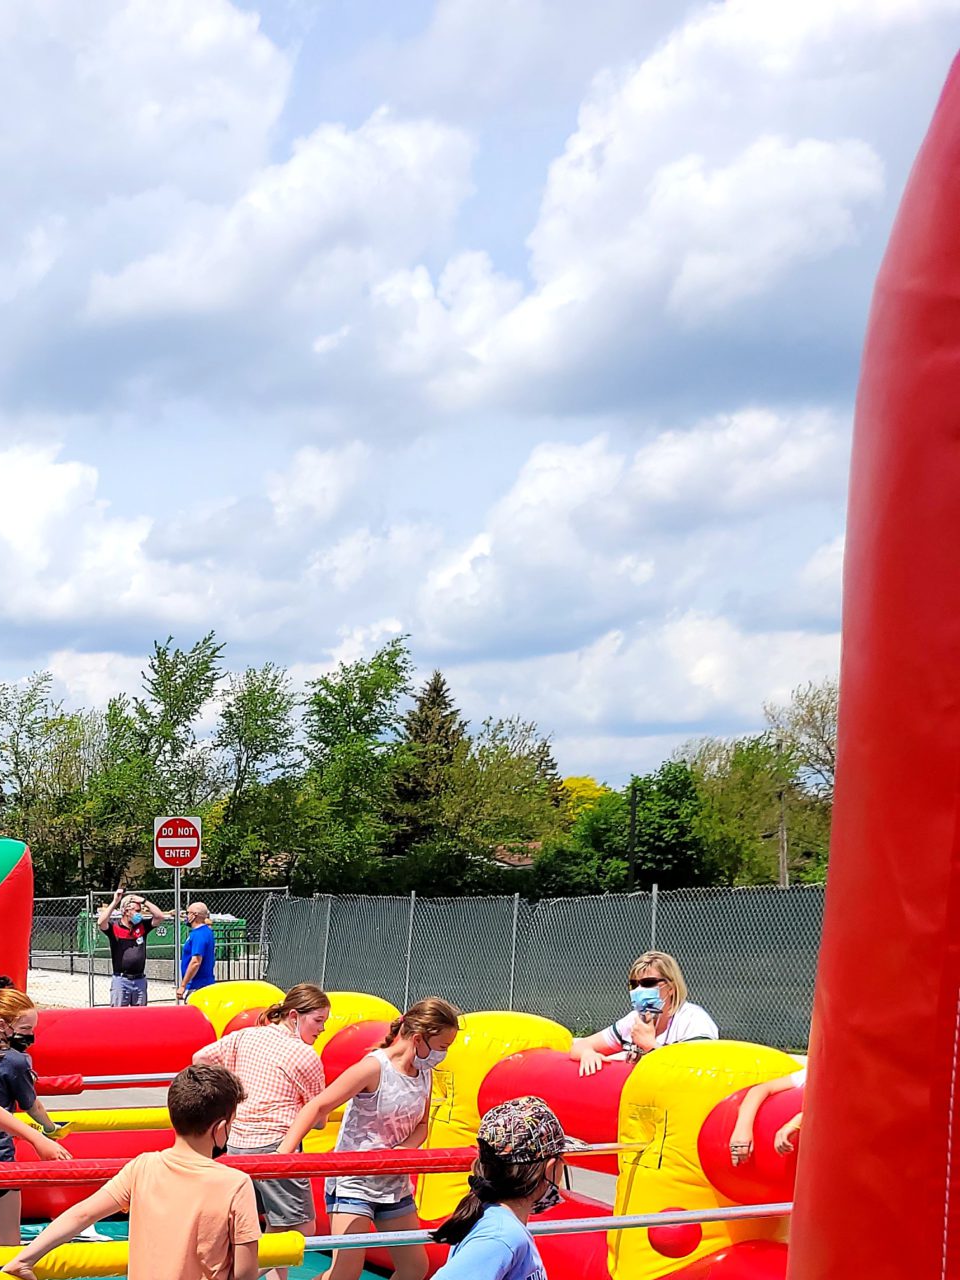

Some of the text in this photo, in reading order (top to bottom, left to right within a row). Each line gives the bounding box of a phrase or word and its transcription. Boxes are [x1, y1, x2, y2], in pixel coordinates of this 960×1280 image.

[162, 827, 194, 836] DO NOT
[165, 849, 190, 858] ENTER
